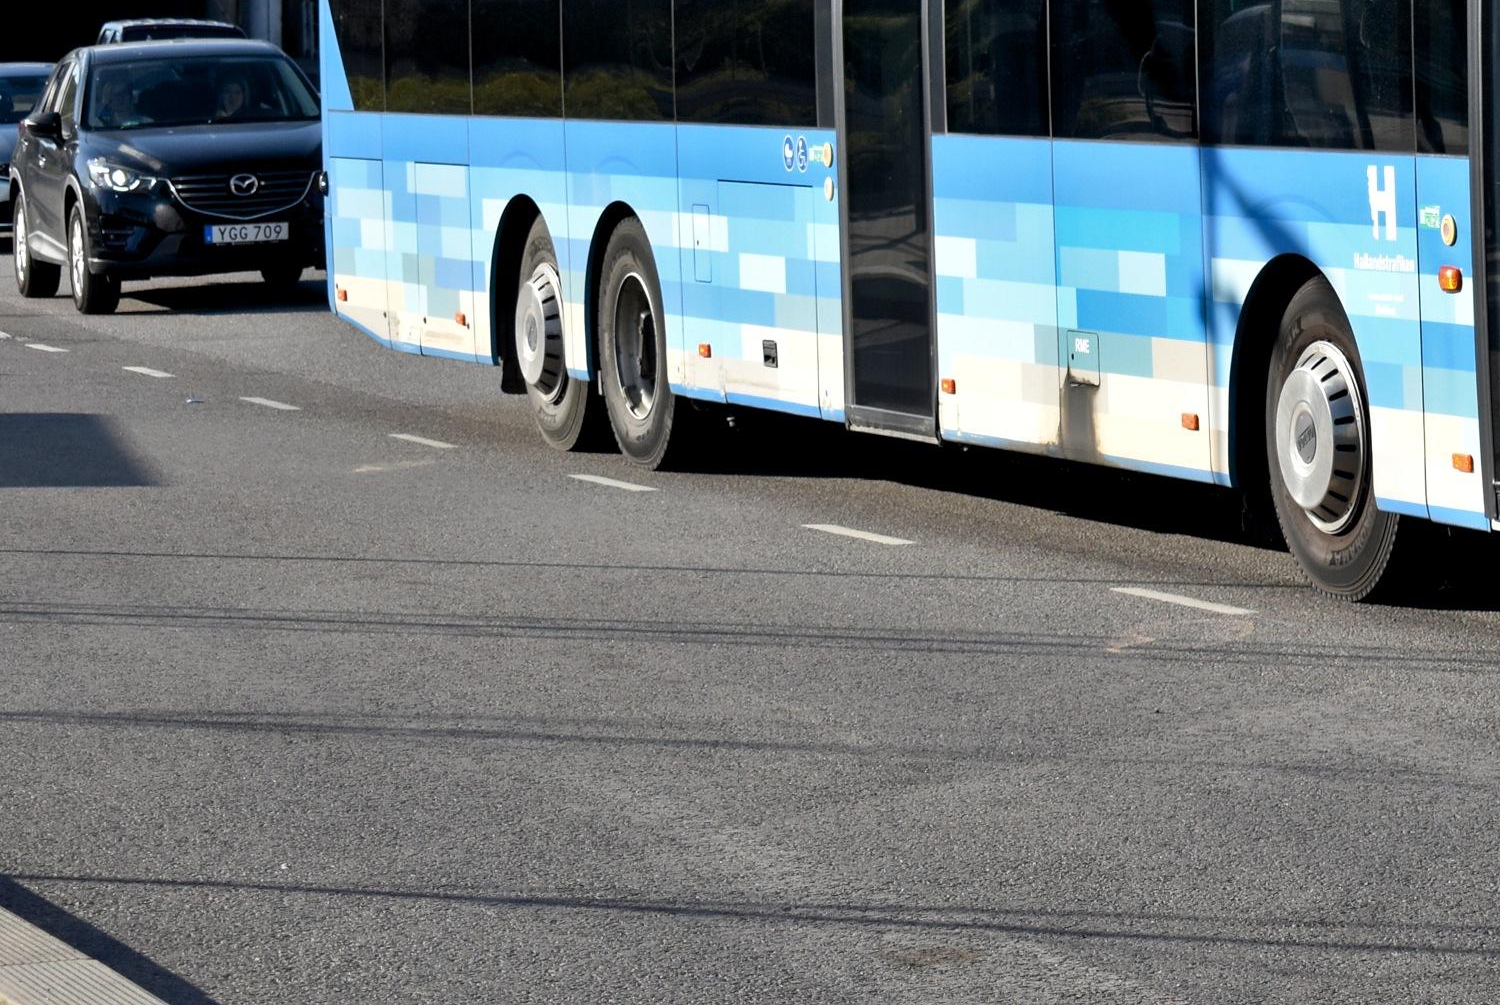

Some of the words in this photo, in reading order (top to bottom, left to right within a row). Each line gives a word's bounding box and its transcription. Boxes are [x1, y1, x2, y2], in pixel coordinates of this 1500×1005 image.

[219, 226, 248, 241] YGG
[253, 225, 282, 239] 709
[1075, 337, 1090, 354] RME
